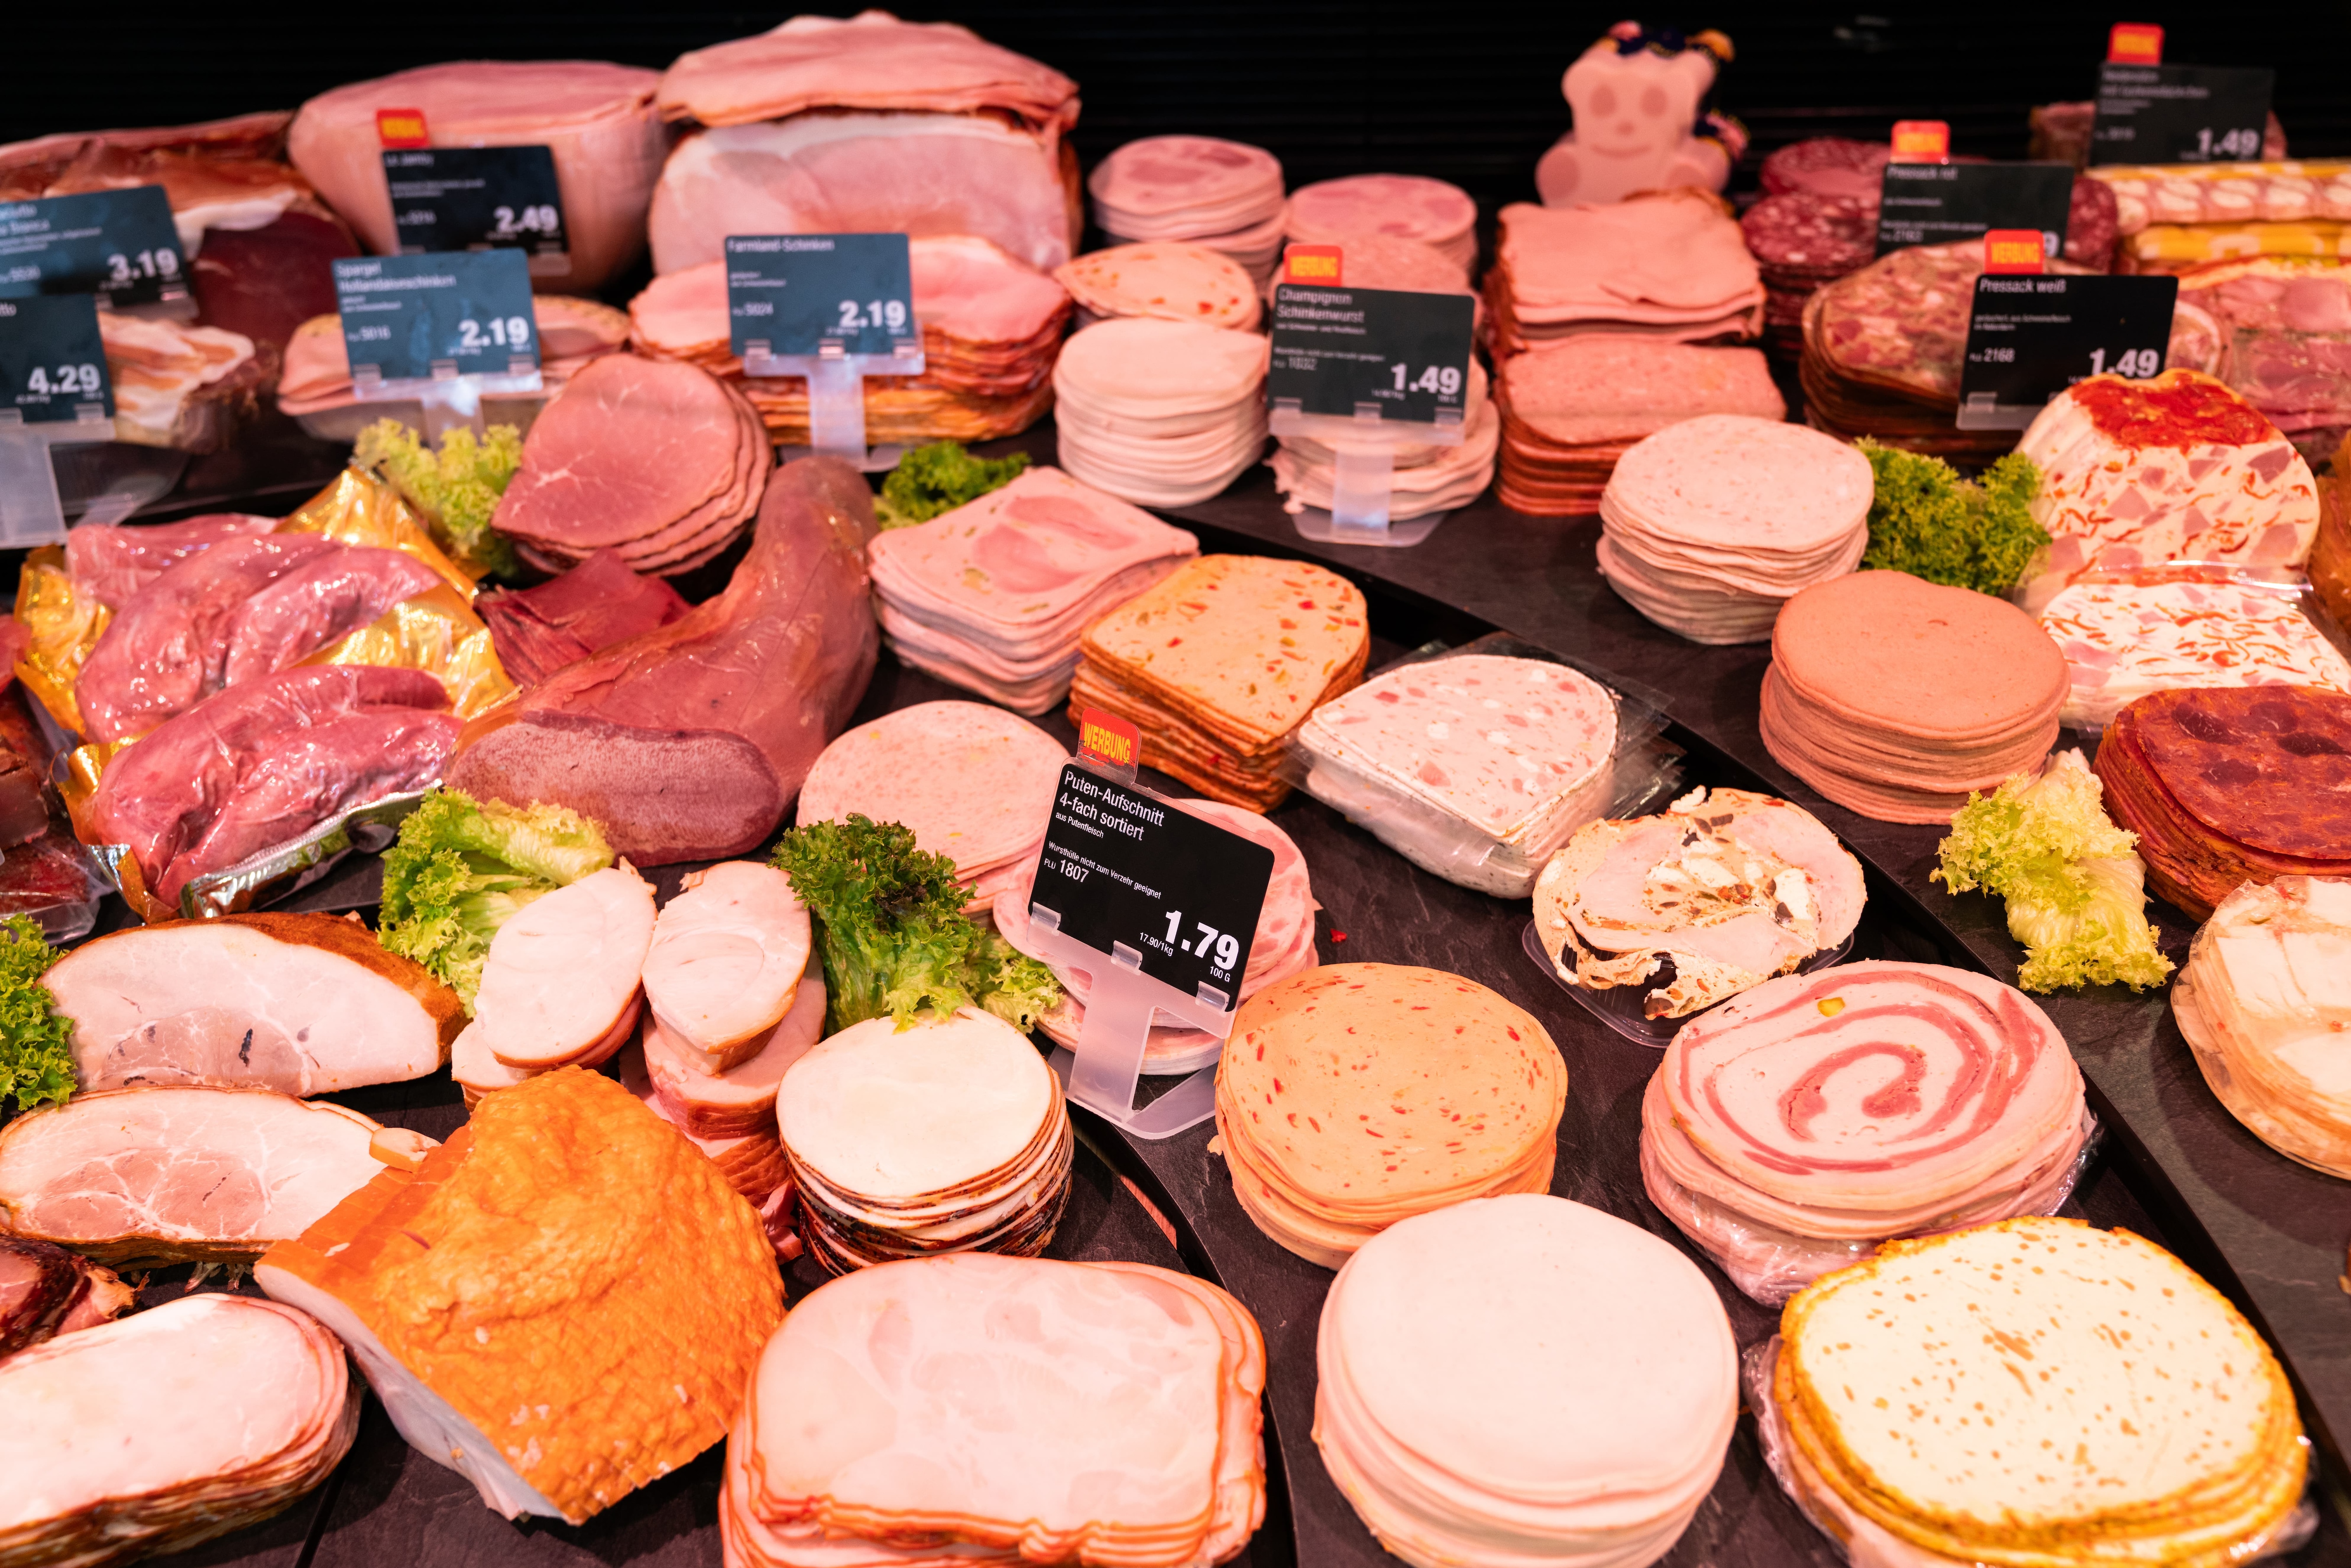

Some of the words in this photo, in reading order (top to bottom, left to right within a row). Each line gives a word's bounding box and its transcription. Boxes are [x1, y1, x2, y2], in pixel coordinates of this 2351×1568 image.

[2196, 127, 2260, 156] 1.49
[494, 204, 559, 232] 2.49
[107, 248, 179, 281] 3.19
[1290, 256, 1338, 277] WERBUNG
[1991, 242, 2041, 264] WERBUNG
[1278, 287, 1353, 306] Champignon
[1980, 277, 2035, 293] Pressack
[2036, 278, 2067, 293] weiß
[838, 299, 906, 328] 2.19
[1277, 304, 1365, 323] Schinkenwurst
[458, 316, 529, 347] 2.19
[2090, 348, 2159, 378] 1.49
[28, 363, 101, 394] 4.29
[1390, 362, 1461, 395] 1.49
[1083, 722, 1131, 764] WERBUNG
[1064, 771, 1165, 827] Puten-Aufschnitt
[1056, 812, 1066, 822] aus
[1067, 816, 1104, 838] Putenfleisch
[1059, 792, 1097, 820] 4-fach
[1100, 812, 1144, 841] sortiert
[1044, 858, 1056, 869] PLU
[1060, 859, 1089, 883] 1807
[1049, 841, 1079, 861] Wursthülle
[1080, 857, 1096, 869] nicht
[1096, 864, 1109, 875] zum
[1111, 869, 1133, 886] Verzehr
[1134, 882, 1161, 899] geeignet
[1140, 932, 1174, 957] 17.90/1kg
[1166, 910, 1239, 970] 1.79
[1210, 966, 1223, 979] 100
[1224, 973, 1231, 982] G
